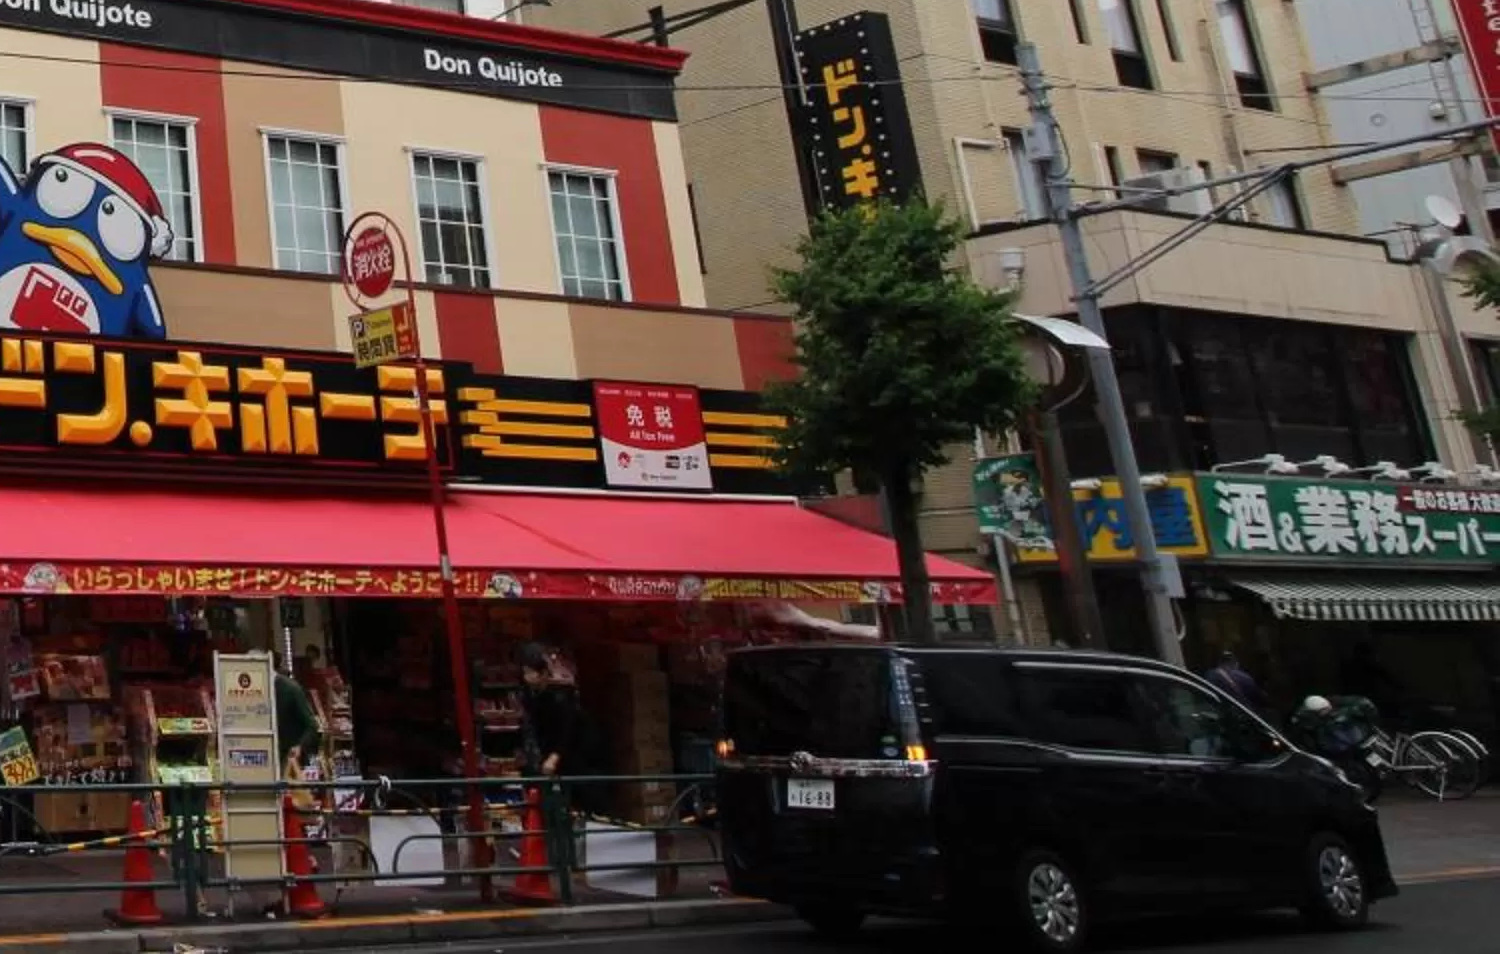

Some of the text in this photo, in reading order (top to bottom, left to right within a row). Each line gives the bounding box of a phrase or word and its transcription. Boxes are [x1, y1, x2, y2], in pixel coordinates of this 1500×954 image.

[424, 49, 563, 88] Don Quijote
[823, 58, 879, 224] ドン.キ
